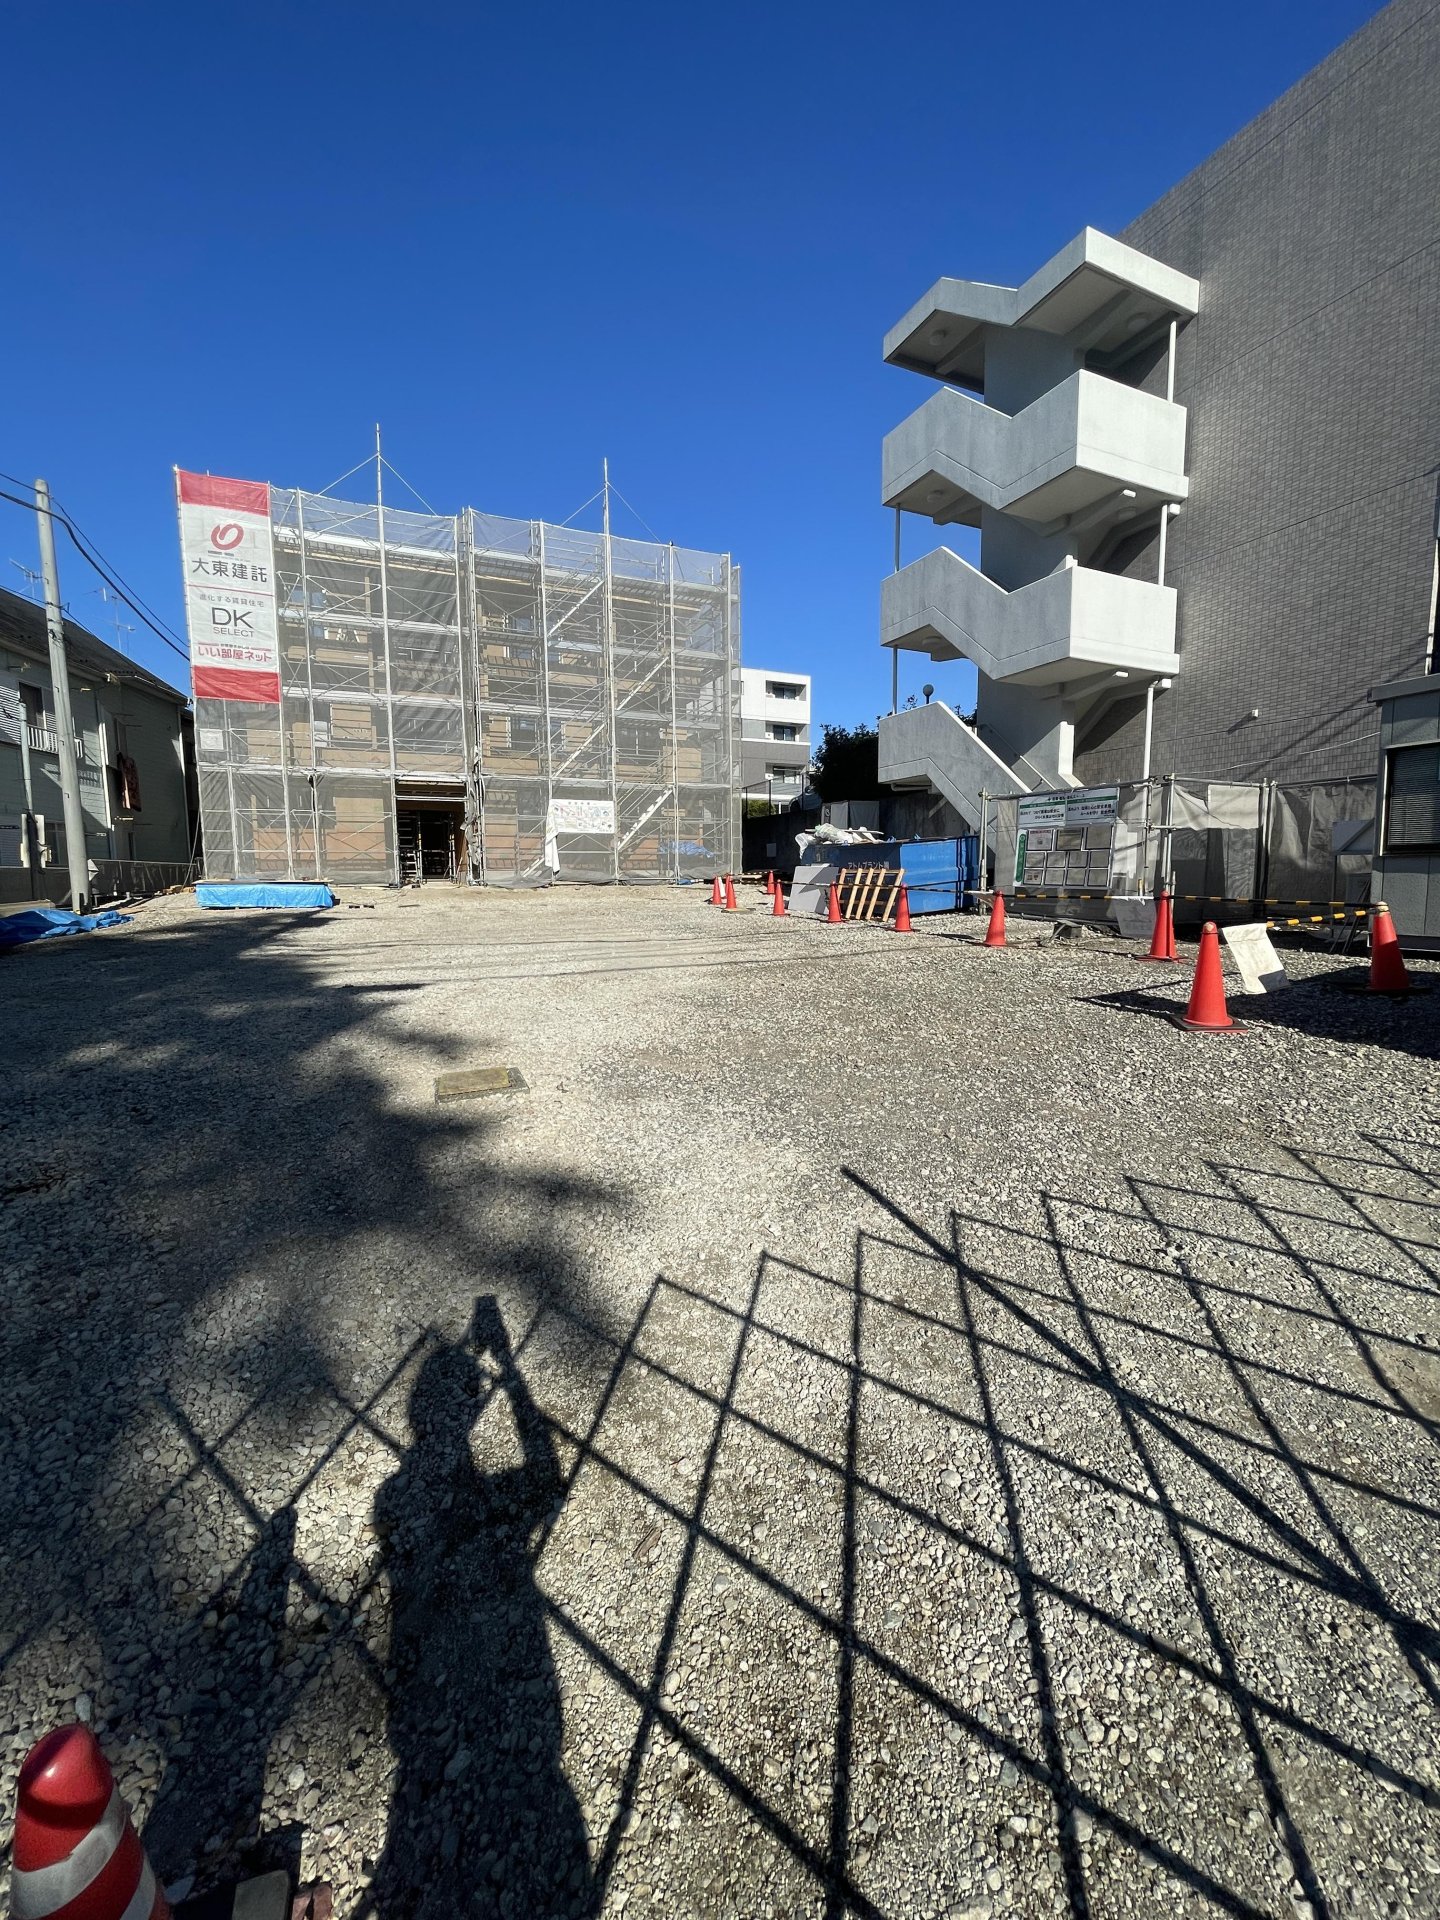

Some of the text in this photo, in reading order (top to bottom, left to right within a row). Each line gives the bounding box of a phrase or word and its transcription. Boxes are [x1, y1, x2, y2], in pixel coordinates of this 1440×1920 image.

[192, 557, 267, 583] 大東建託
[200, 593, 265, 607] 進化する賃貸住宅
[211, 606, 254, 629] DK
[213, 627, 255, 638] SELECT
[198, 646, 272, 662] いい部屋ネット
